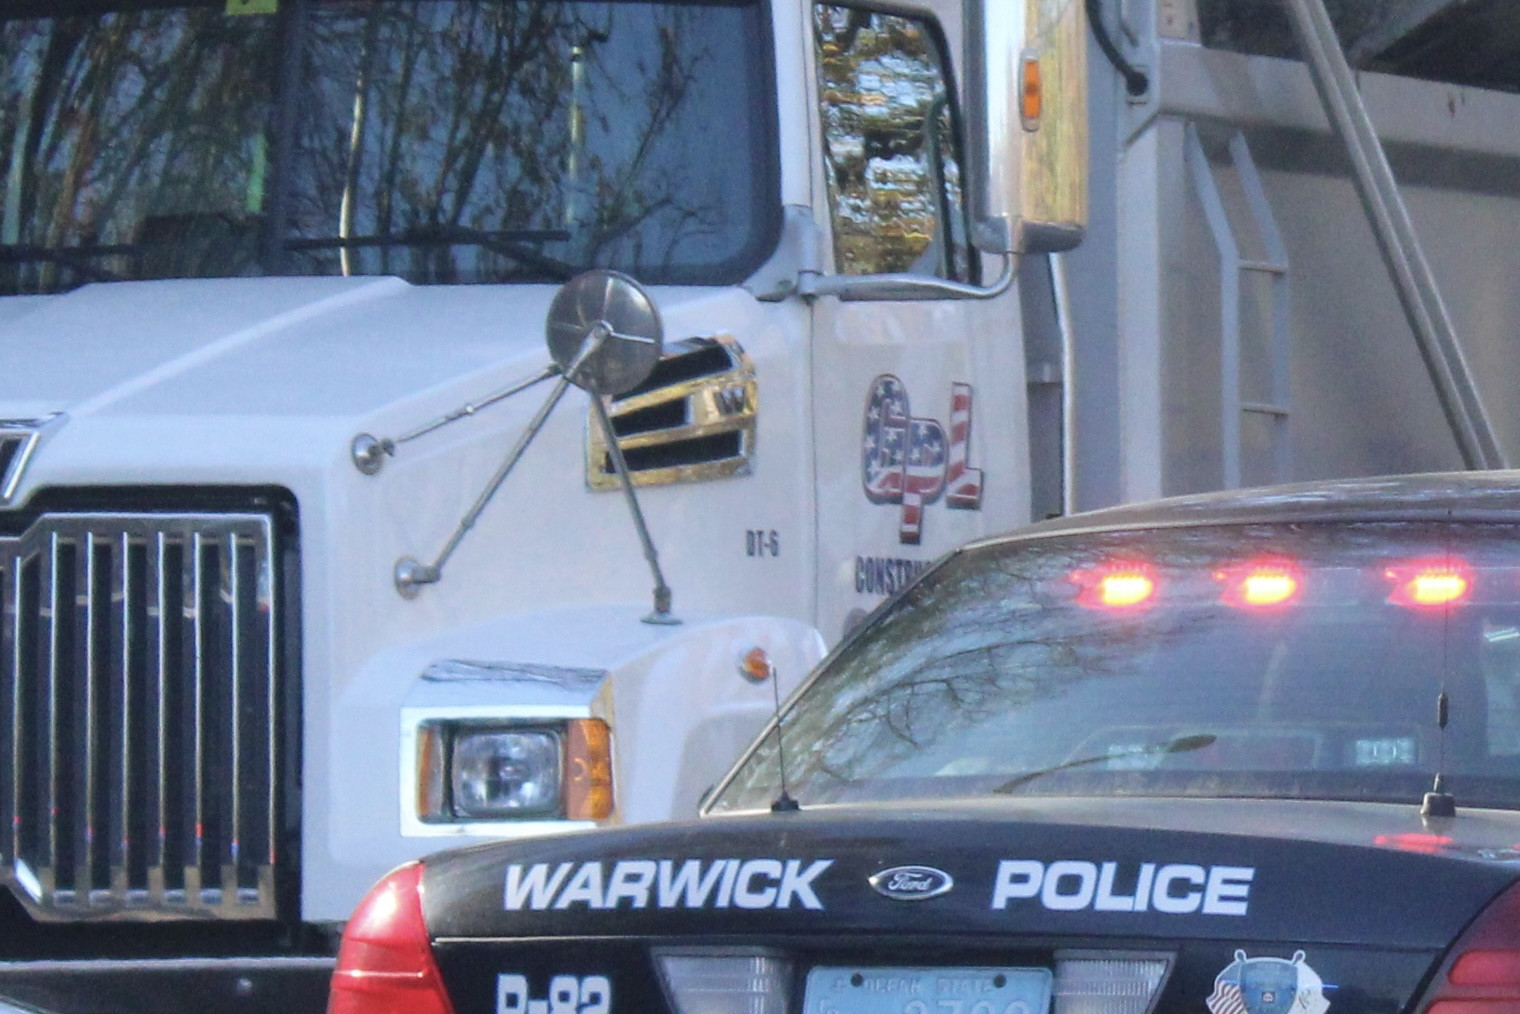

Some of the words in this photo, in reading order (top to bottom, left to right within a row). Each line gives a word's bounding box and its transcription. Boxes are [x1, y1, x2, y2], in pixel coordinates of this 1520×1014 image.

[746, 530, 780, 557] DT-6
[502, 858, 835, 911] WARWICK
[887, 872, 933, 891] Ford
[992, 860, 1255, 915] POLICE
